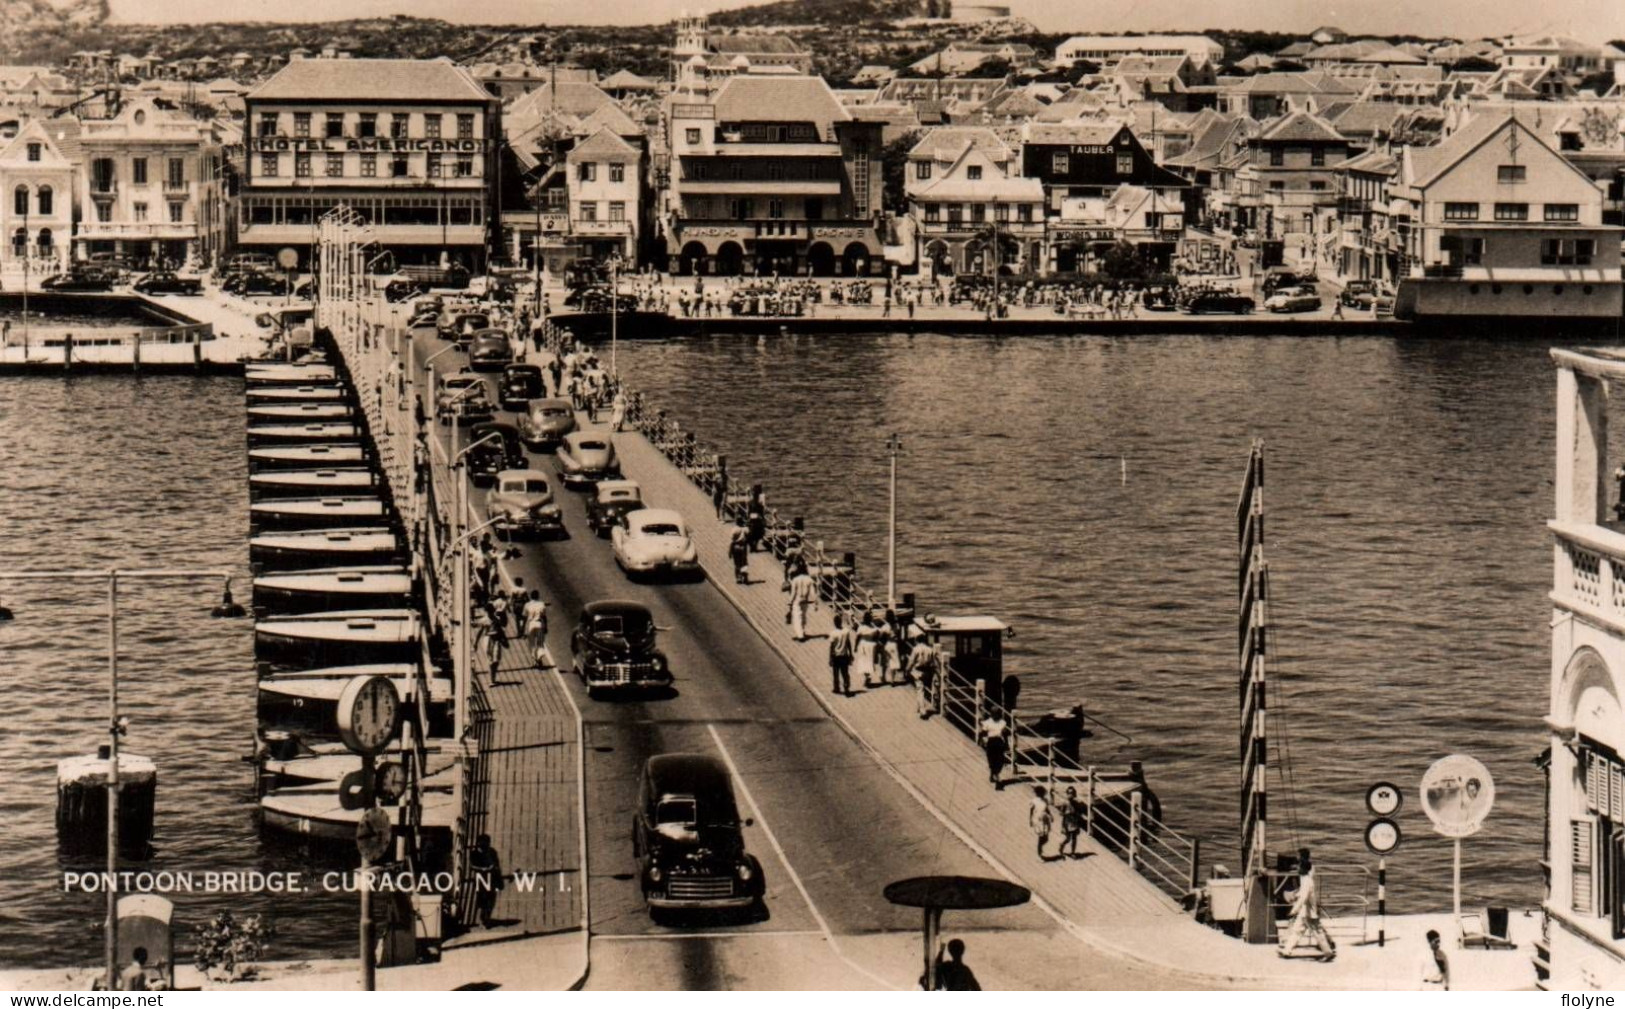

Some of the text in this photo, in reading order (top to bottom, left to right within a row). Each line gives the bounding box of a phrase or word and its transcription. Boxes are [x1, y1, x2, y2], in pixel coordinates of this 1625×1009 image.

[259, 139, 475, 151] HOTEL AMERICANO
[1070, 145, 1114, 154] TAUBER
